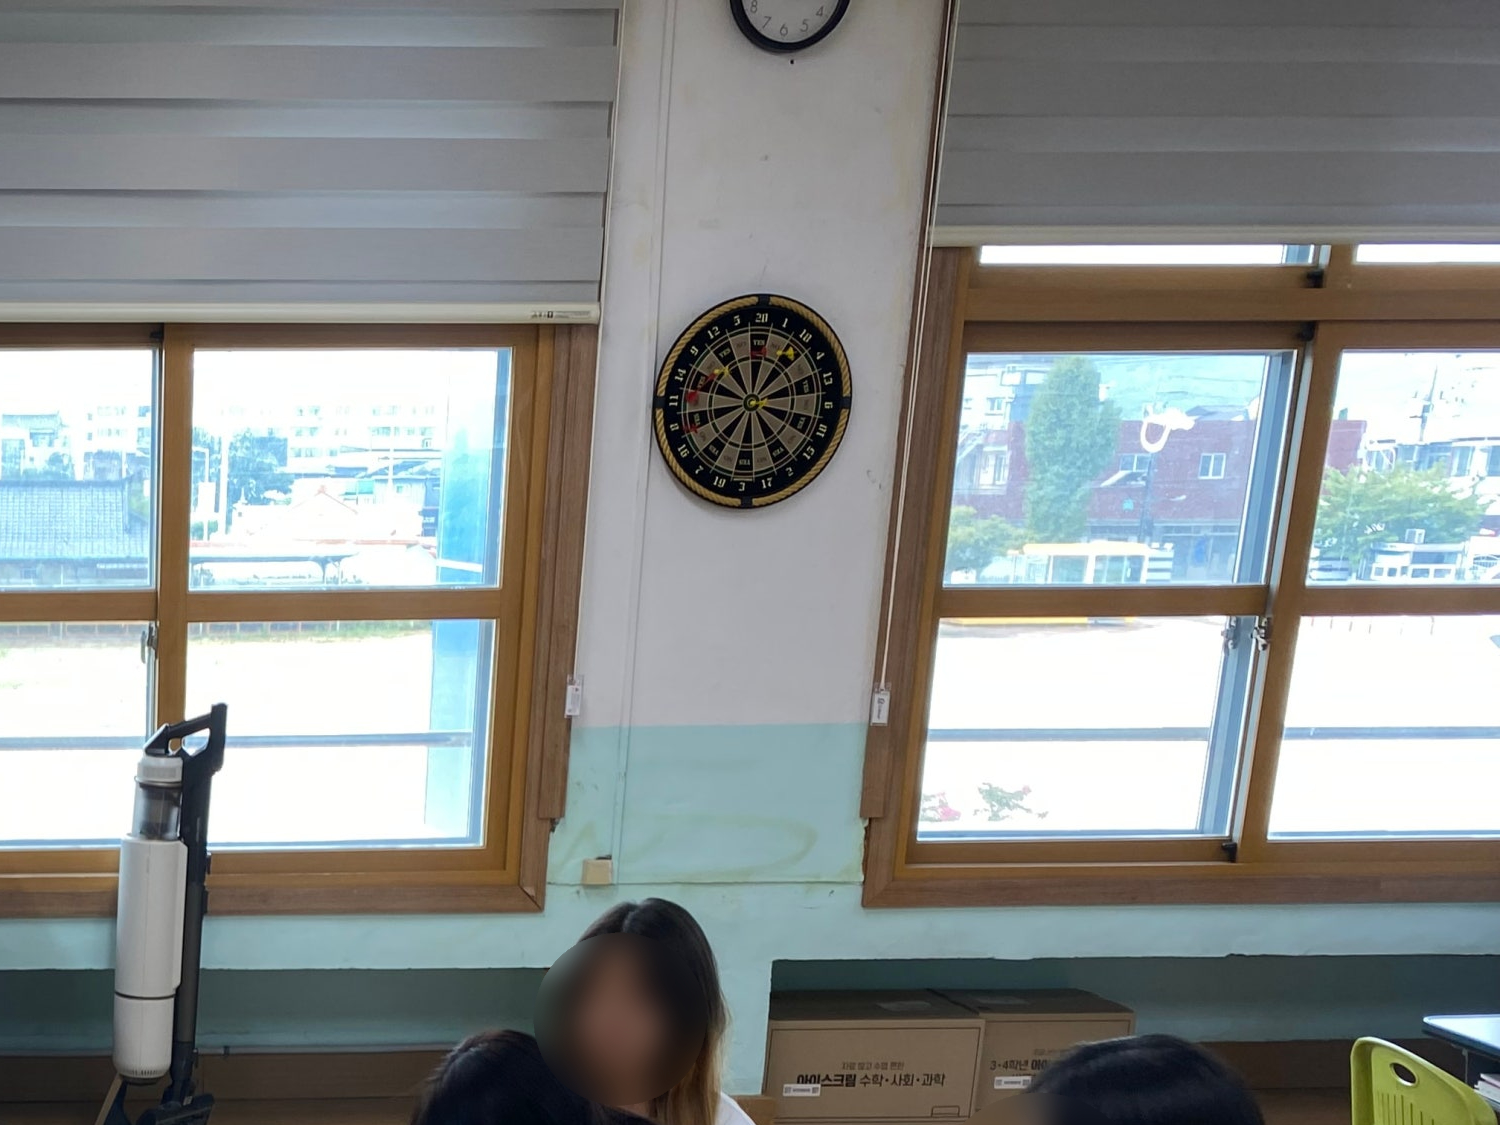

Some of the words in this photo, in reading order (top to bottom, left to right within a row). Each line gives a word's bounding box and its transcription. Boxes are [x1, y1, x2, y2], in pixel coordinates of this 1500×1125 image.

[750, 0, 758, 13] 8
[815, 6, 824, 17] 4
[762, 16, 772, 29] 7
[800, 19, 809, 32] 5
[780, 23, 788, 36] 6
[782, 318, 789, 328] 1
[707, 327, 721, 340] 12
[675, 368, 686, 382] 14
[823, 372, 833, 386] 13
[669, 394, 679, 407] 11
[677, 444, 690, 458] 16
[802, 446, 815, 460] 15
[695, 465, 704, 475] 7
[713, 476, 726, 488] 19
[738, 482, 746, 492] 3
[761, 478, 773, 489] 17
[796, 1073, 857, 1088] 아이스크림
